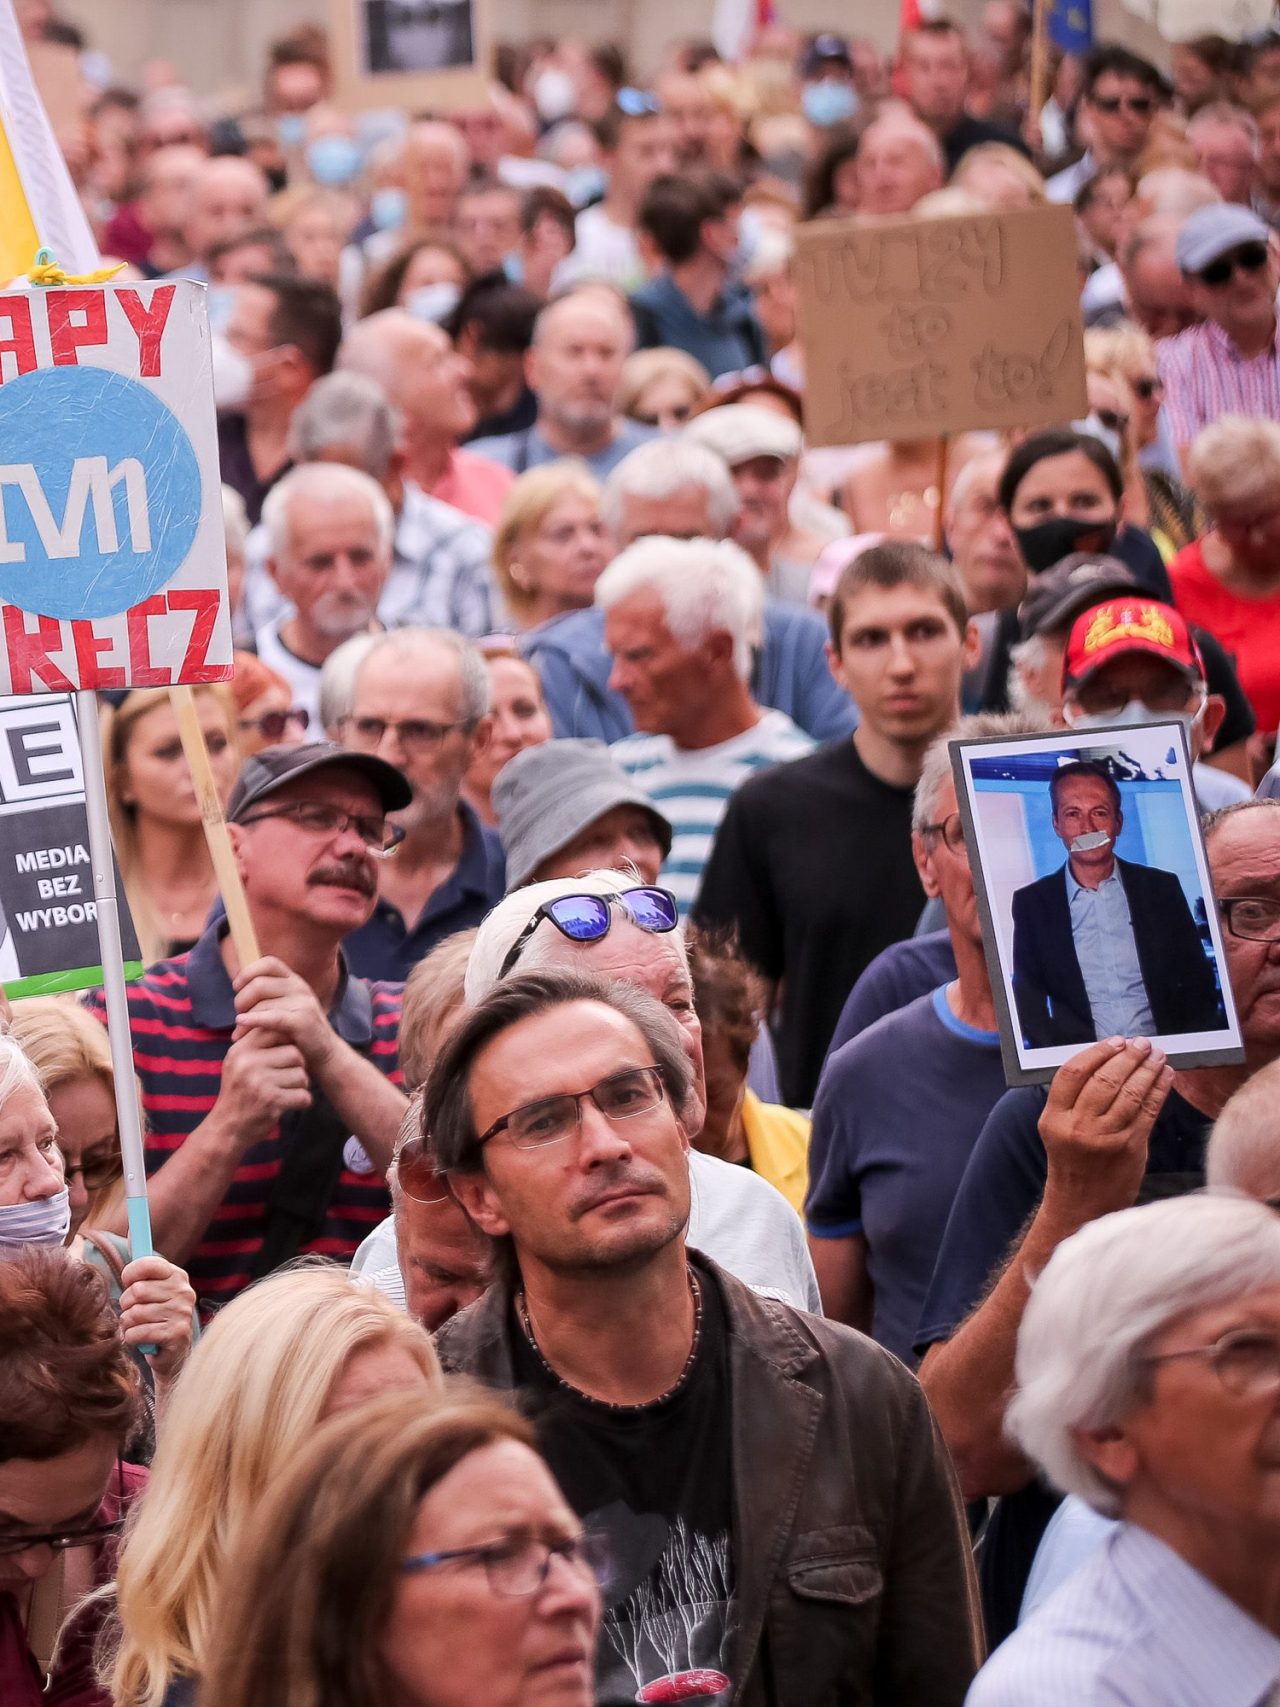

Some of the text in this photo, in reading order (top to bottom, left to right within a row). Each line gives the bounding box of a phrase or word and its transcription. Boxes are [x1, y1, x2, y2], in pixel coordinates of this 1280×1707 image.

[878, 305, 954, 361] to
[15, 844, 90, 874] MEDIA
[37, 874, 83, 900] BEZ
[15, 901, 98, 932] WYBOR
